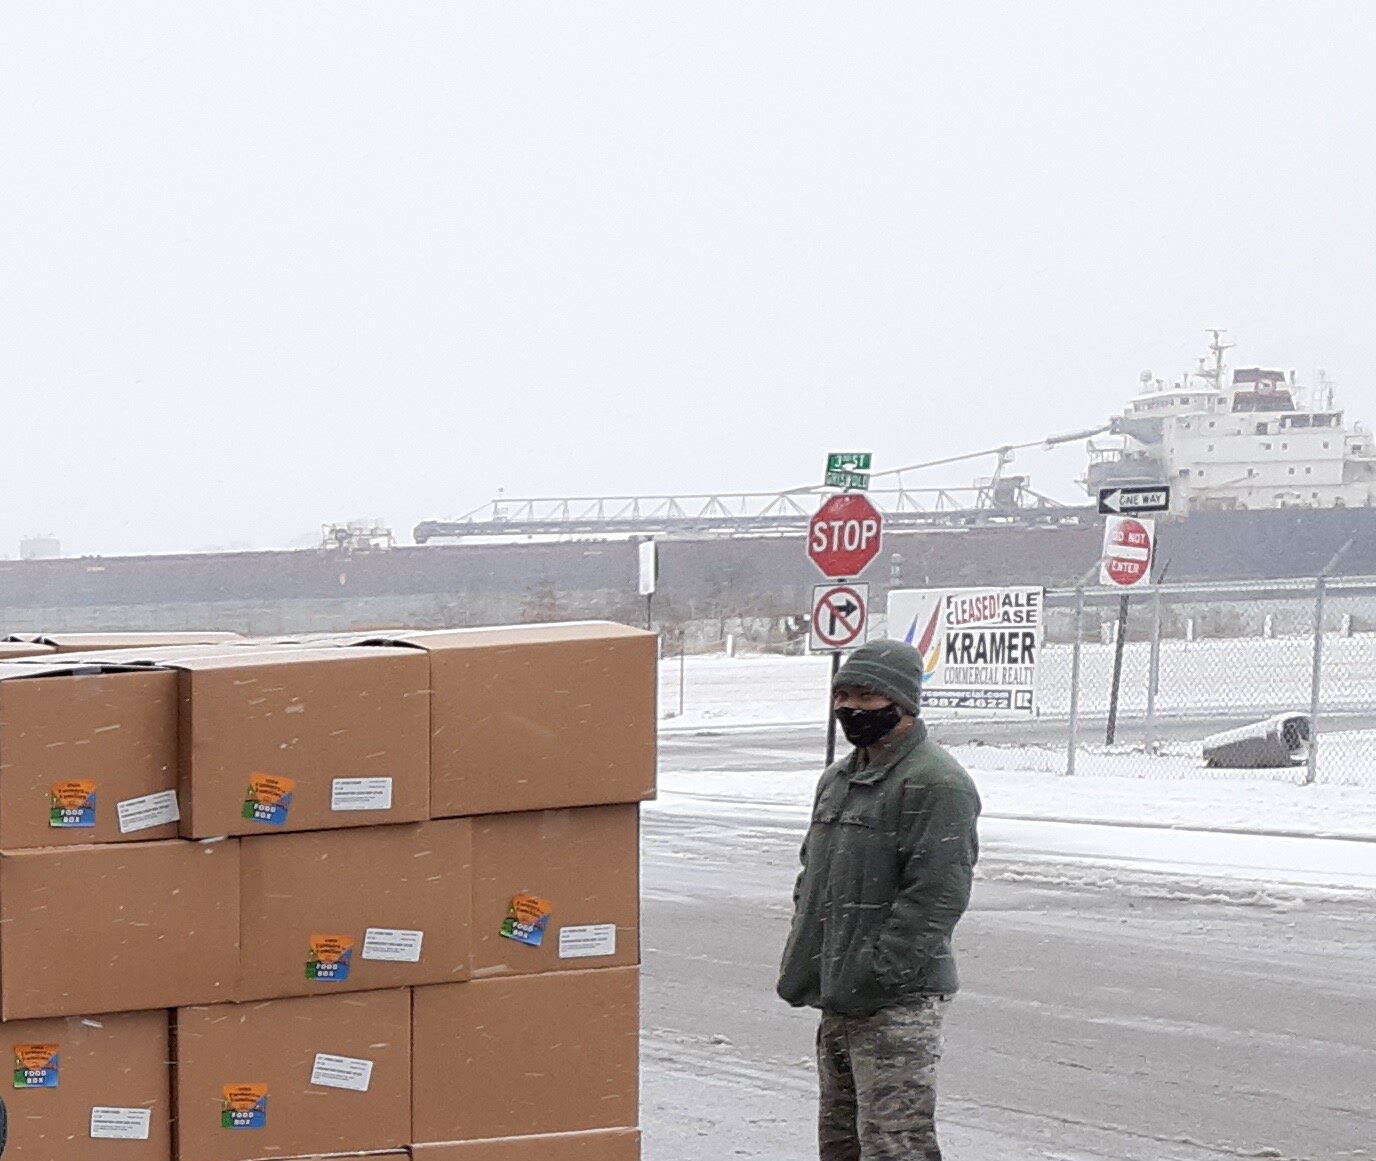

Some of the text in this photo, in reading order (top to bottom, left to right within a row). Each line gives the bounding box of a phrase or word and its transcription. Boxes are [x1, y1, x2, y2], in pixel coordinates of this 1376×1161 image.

[1120, 494, 1162, 505] ONE WAY
[812, 520, 877, 552] STOP
[1112, 531, 1146, 544] DO NOT
[1111, 560, 1139, 573] ENTER
[1002, 592, 1040, 607] ALE
[954, 594, 1000, 625] LEASED!
[1002, 609, 1038, 623] ASE
[946, 632, 1035, 664] KRAMER
[944, 667, 1035, 685] COMMERCIAL REALTY
[921, 690, 1009, 698] rcommercial.com
[920, 698, 1009, 708] -987-4622
